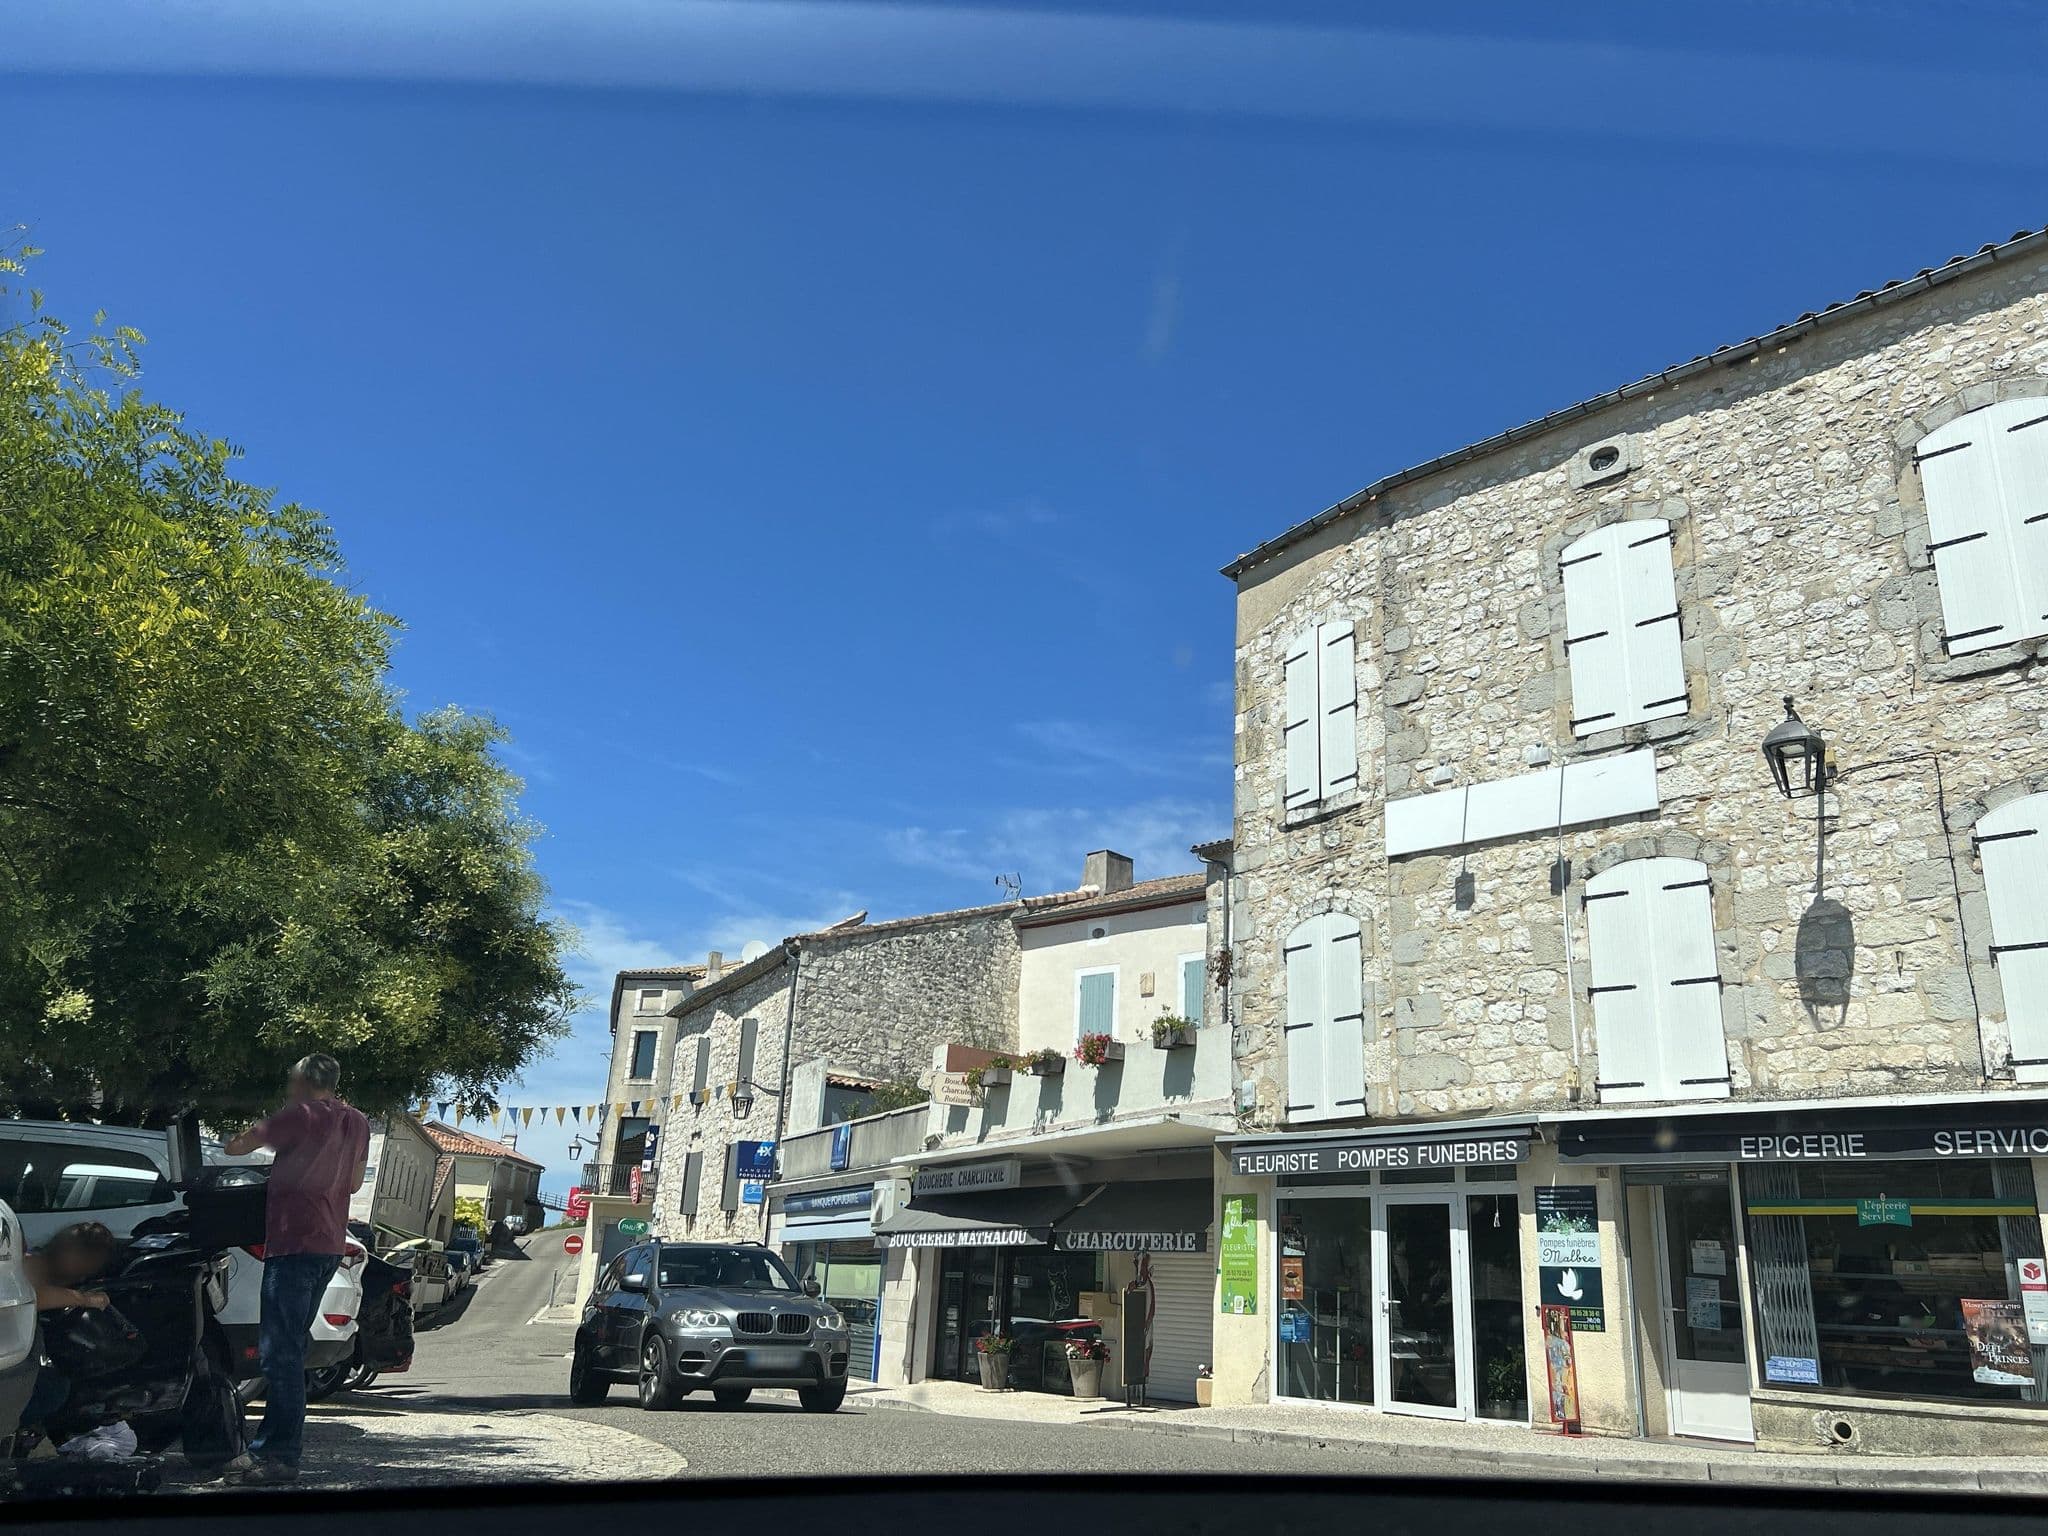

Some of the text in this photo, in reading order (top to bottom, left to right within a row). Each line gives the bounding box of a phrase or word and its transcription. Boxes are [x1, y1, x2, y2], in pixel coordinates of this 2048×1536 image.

[1740, 1134, 1866, 1158] EPICERIE
[1239, 1140, 1519, 1173] FLEURISTE POMPES FUNEBRES
[631, 1167, 639, 1204] TABAC
[918, 1167, 1005, 1190] BOUCHERIE CHARCUTERIE
[1864, 1199, 1907, 1213] L'épicerie
[1862, 1211, 1896, 1222] Service
[622, 1223, 636, 1231] PMU
[889, 1230, 956, 1247] BOUCHERIE
[1066, 1230, 1196, 1250] CHARCUTERIE
[1540, 1237, 1596, 1248] Pompes funèbres
[1223, 1243, 1255, 1251] FLEURISTE
[1542, 1248, 1597, 1263] Malbec
[1988, 1351, 2030, 1364] PRINCES
